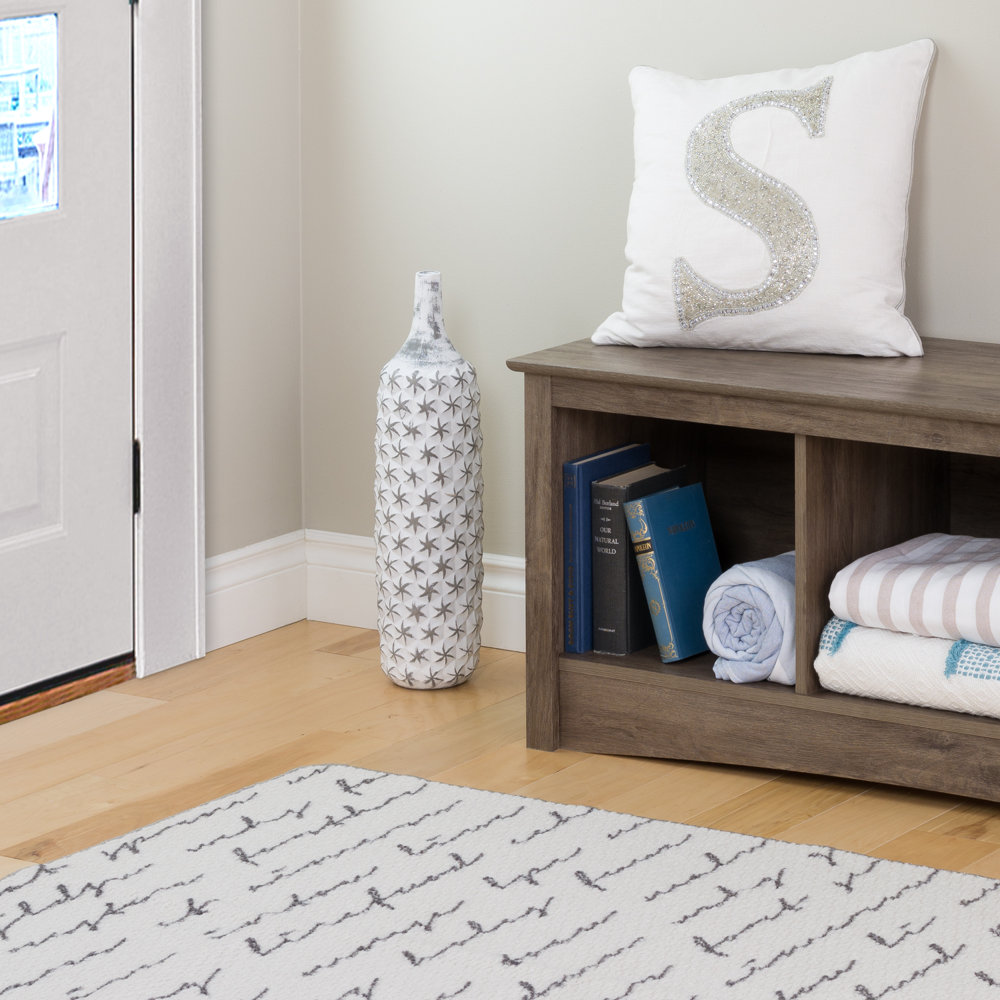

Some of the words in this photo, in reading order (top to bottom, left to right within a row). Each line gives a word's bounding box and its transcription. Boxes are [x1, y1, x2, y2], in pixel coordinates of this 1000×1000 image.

[672, 75, 834, 331] S
[594, 535, 620, 545] NATURAL
[596, 546, 617, 555] WORLD
